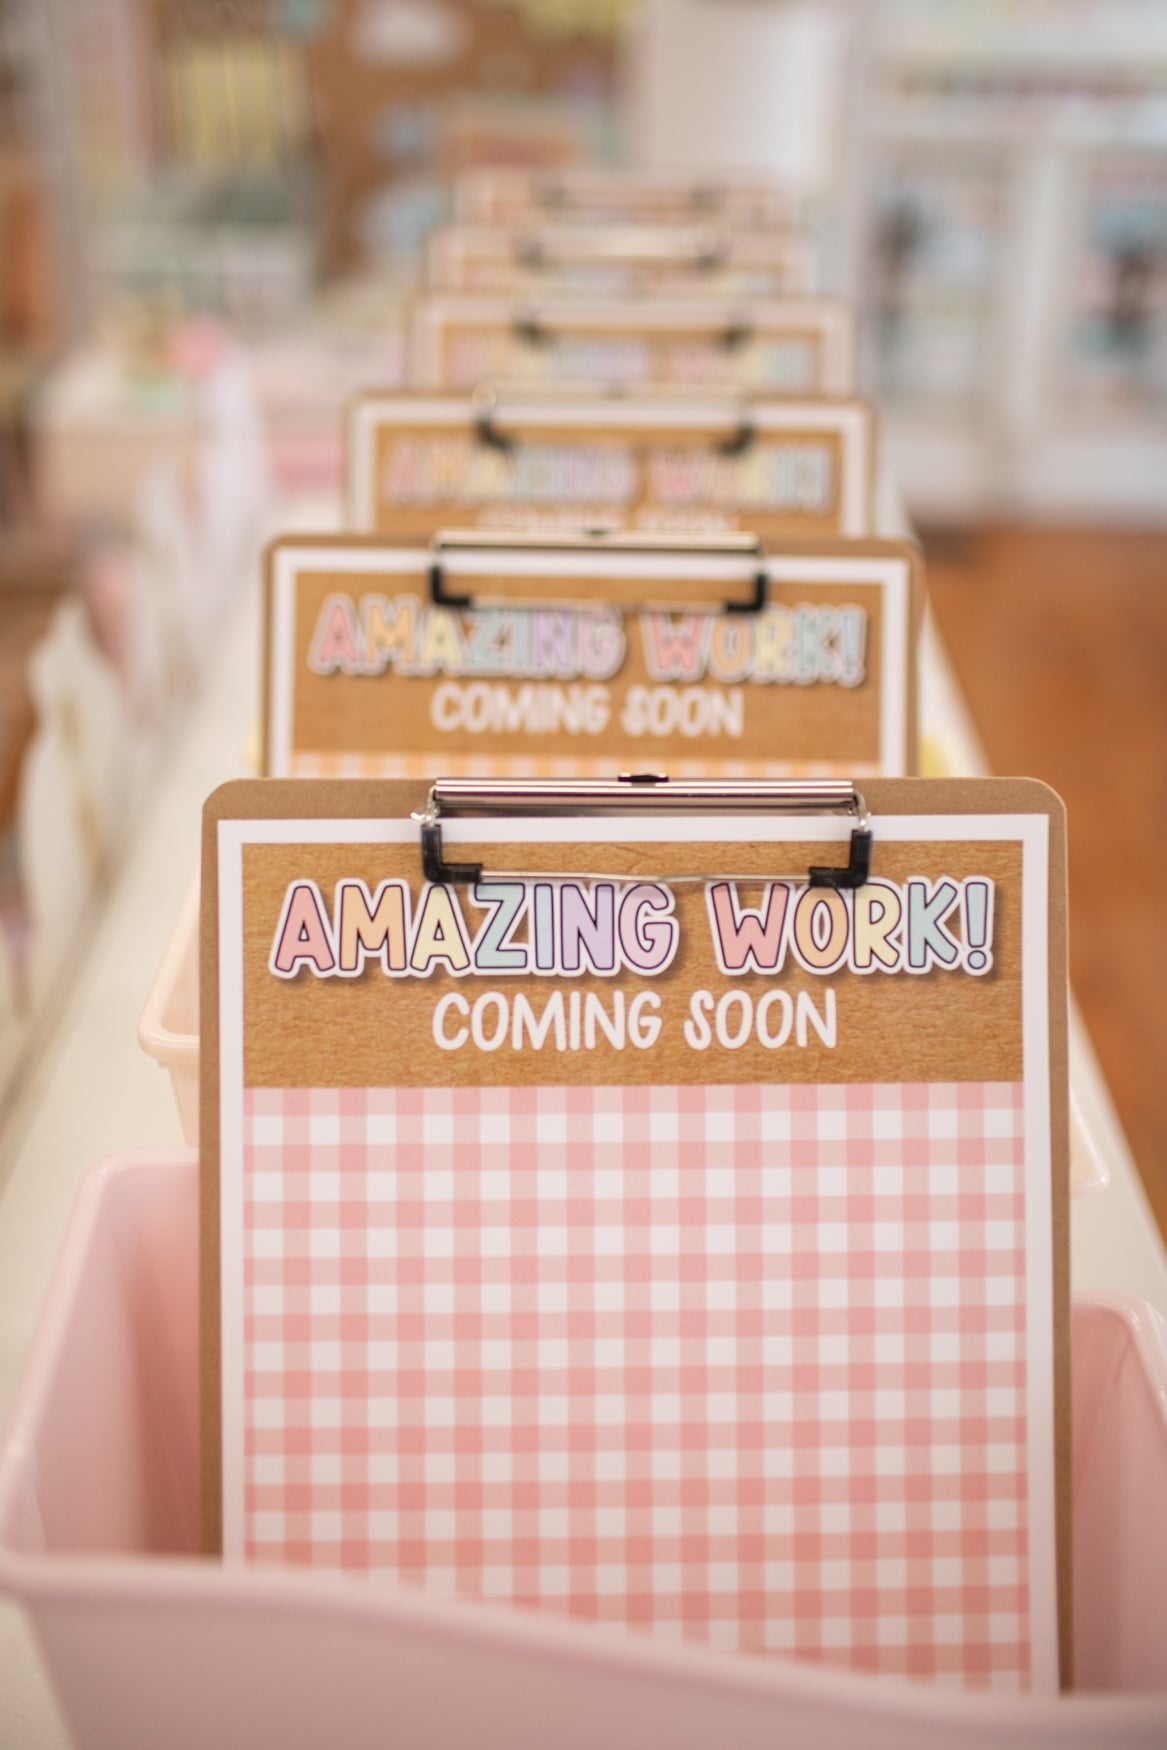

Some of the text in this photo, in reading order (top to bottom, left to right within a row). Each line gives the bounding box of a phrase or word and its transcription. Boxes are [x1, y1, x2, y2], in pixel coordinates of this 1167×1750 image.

[309, 593, 866, 685] AMAZING WORK!
[431, 684, 744, 737] COMING SOON
[270, 876, 995, 978] AMAZING WORK!
[432, 988, 838, 1052] COMING SOON
